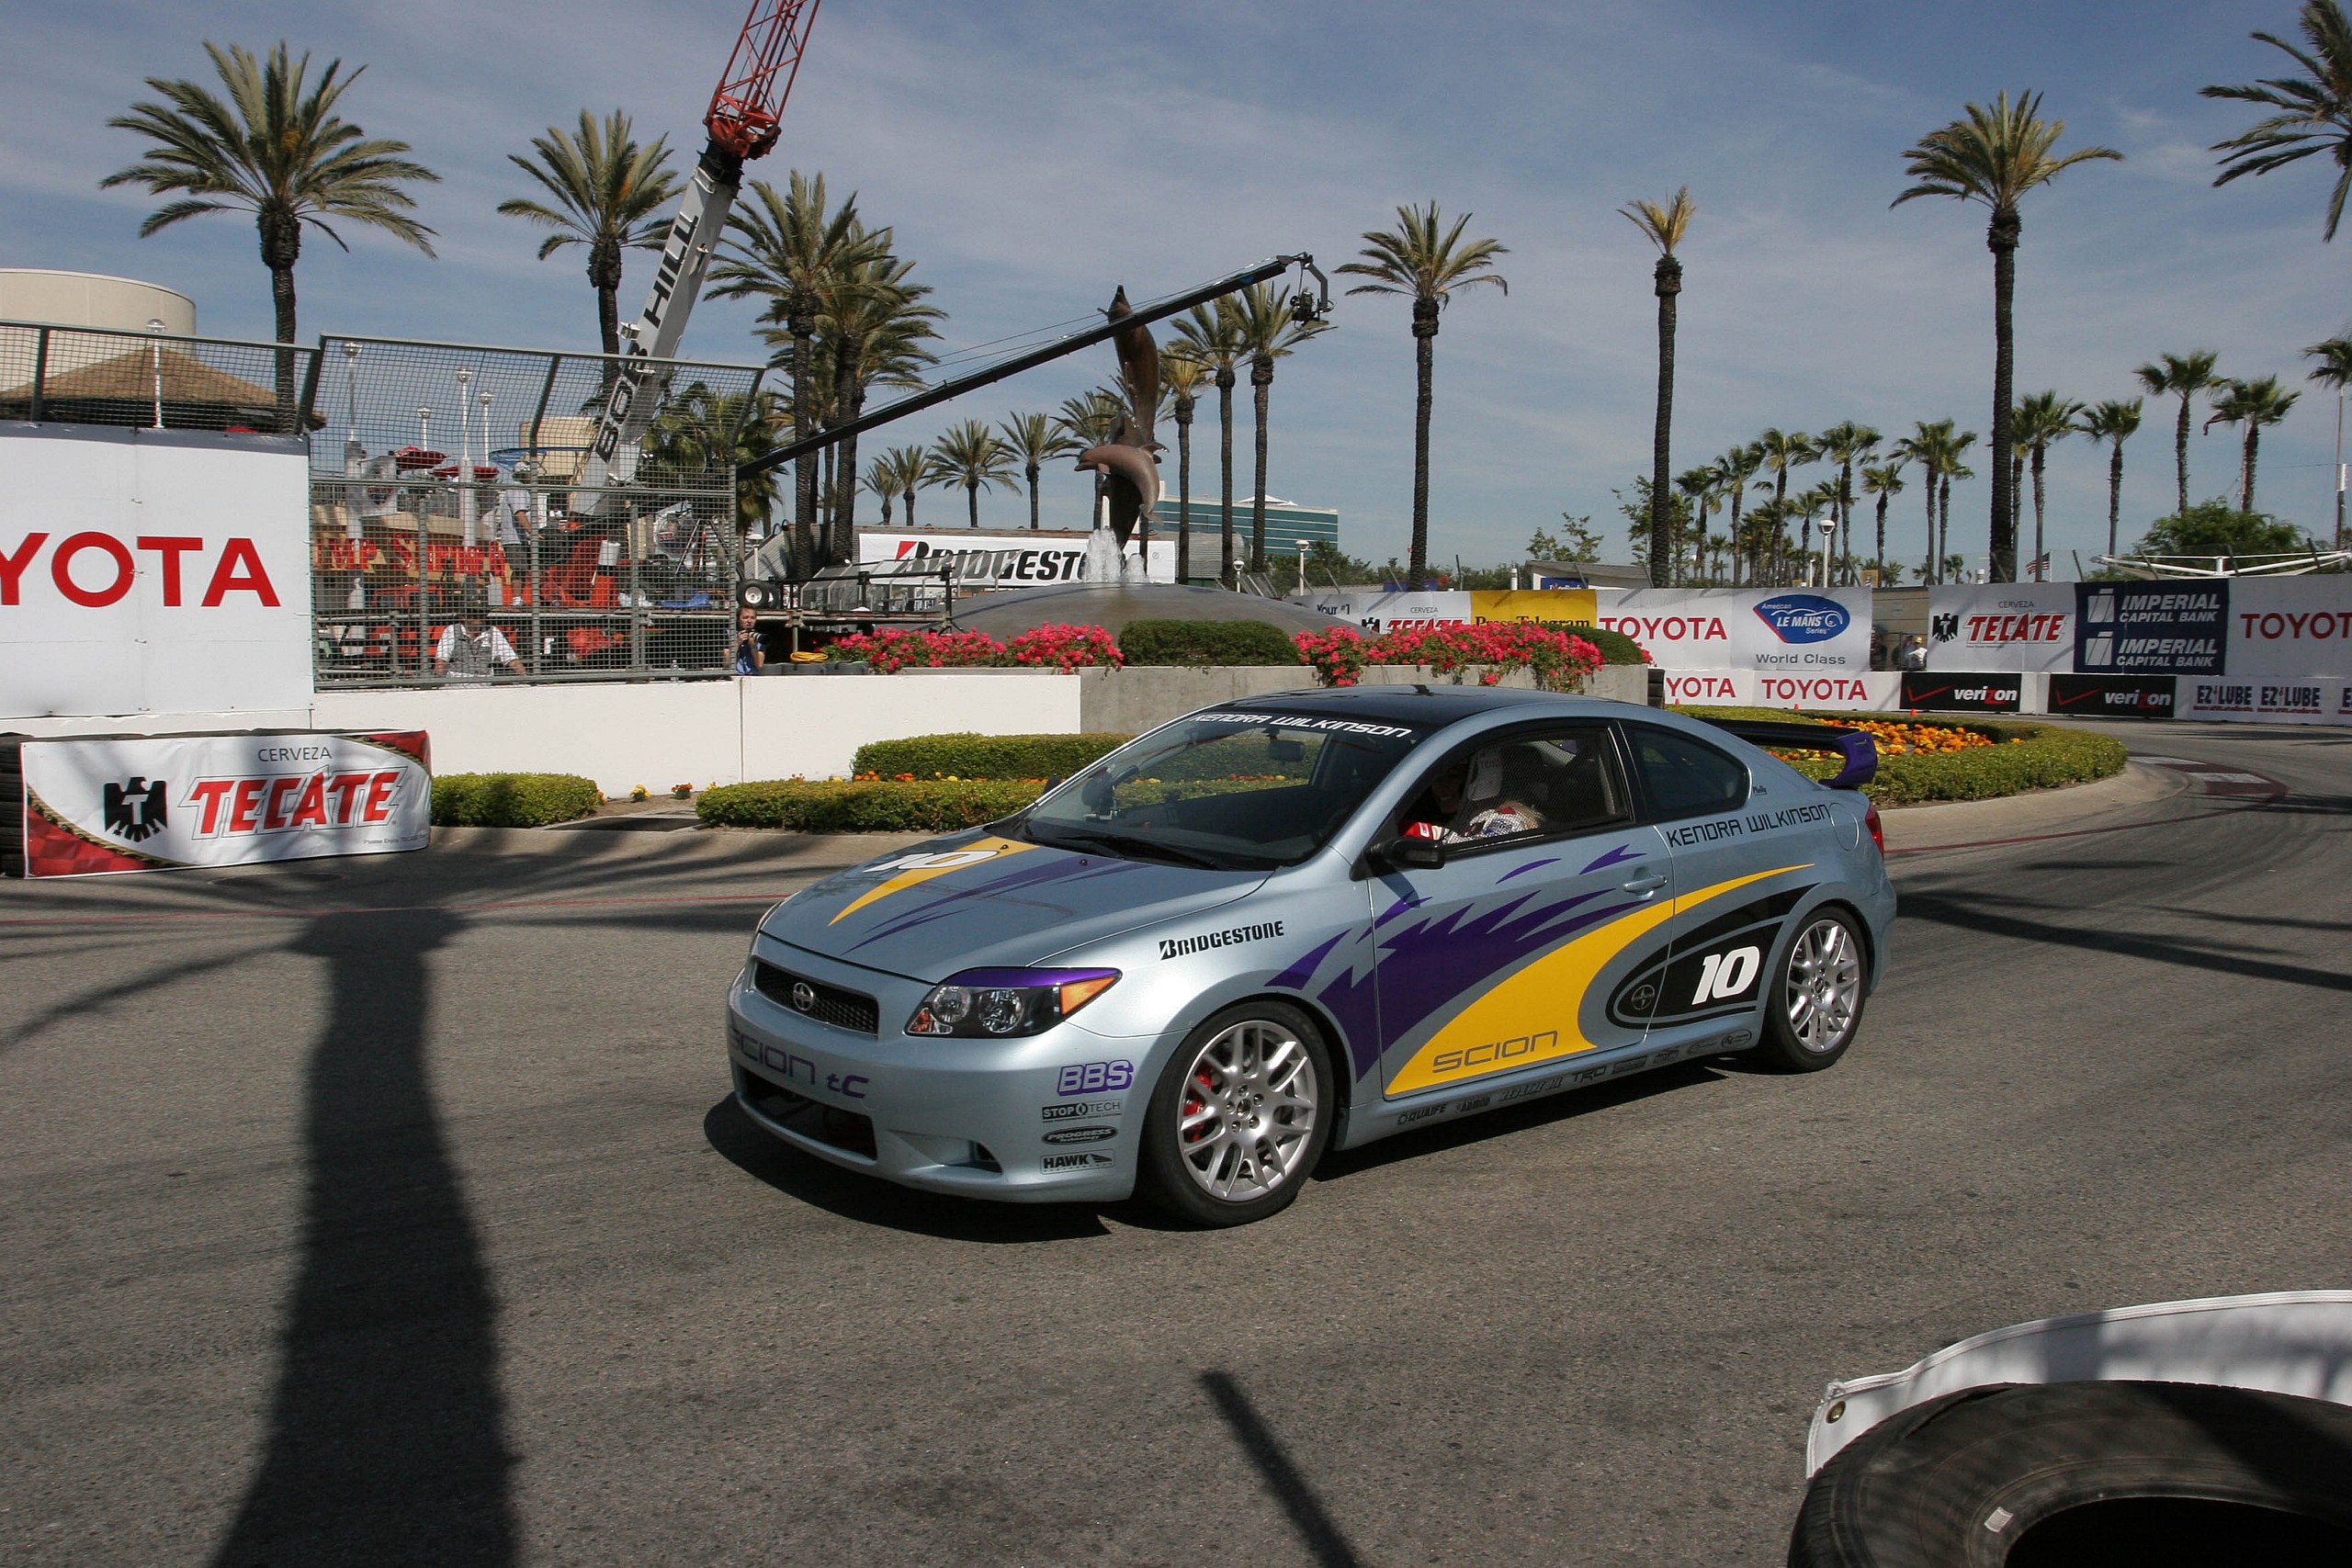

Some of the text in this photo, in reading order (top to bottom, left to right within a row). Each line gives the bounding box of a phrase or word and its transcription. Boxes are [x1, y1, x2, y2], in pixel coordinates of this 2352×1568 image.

[643, 215, 699, 329] HILL
[896, 540, 1087, 581] BRIDGEST
[1316, 604, 1351, 615] Your #1
[1998, 600, 2034, 609] CERVEZA
[2120, 592, 2221, 611] IMPERIAL
[1776, 616, 1822, 627] LE MANS
[1965, 613, 2067, 642] TECATE
[2119, 611, 2217, 623] CAPITAL BANK
[1599, 616, 1728, 641] TOYOTA
[2118, 637, 2218, 656] IMPERIAL
[1756, 653, 1847, 665] World Class
[2116, 656, 2214, 668] CAPITAL BANK
[1761, 678, 1868, 701] TOYOTA
[1954, 686, 2018, 705] verizon
[2104, 689, 2171, 709] verizon
[1193, 713, 1412, 738] KENDRA WILKINSON
[258, 746, 333, 762] CERVEZA
[189, 770, 402, 834] TECATE
[1666, 804, 1832, 849] KENDRA WILKINSON
[861, 850, 1001, 874] 10
[1159, 920, 1284, 961] BRIDGESTONE
[1691, 945, 1760, 1006] 10
[1057, 1059, 1134, 1097] BBS
[1044, 1153, 1091, 1169] HAWK
